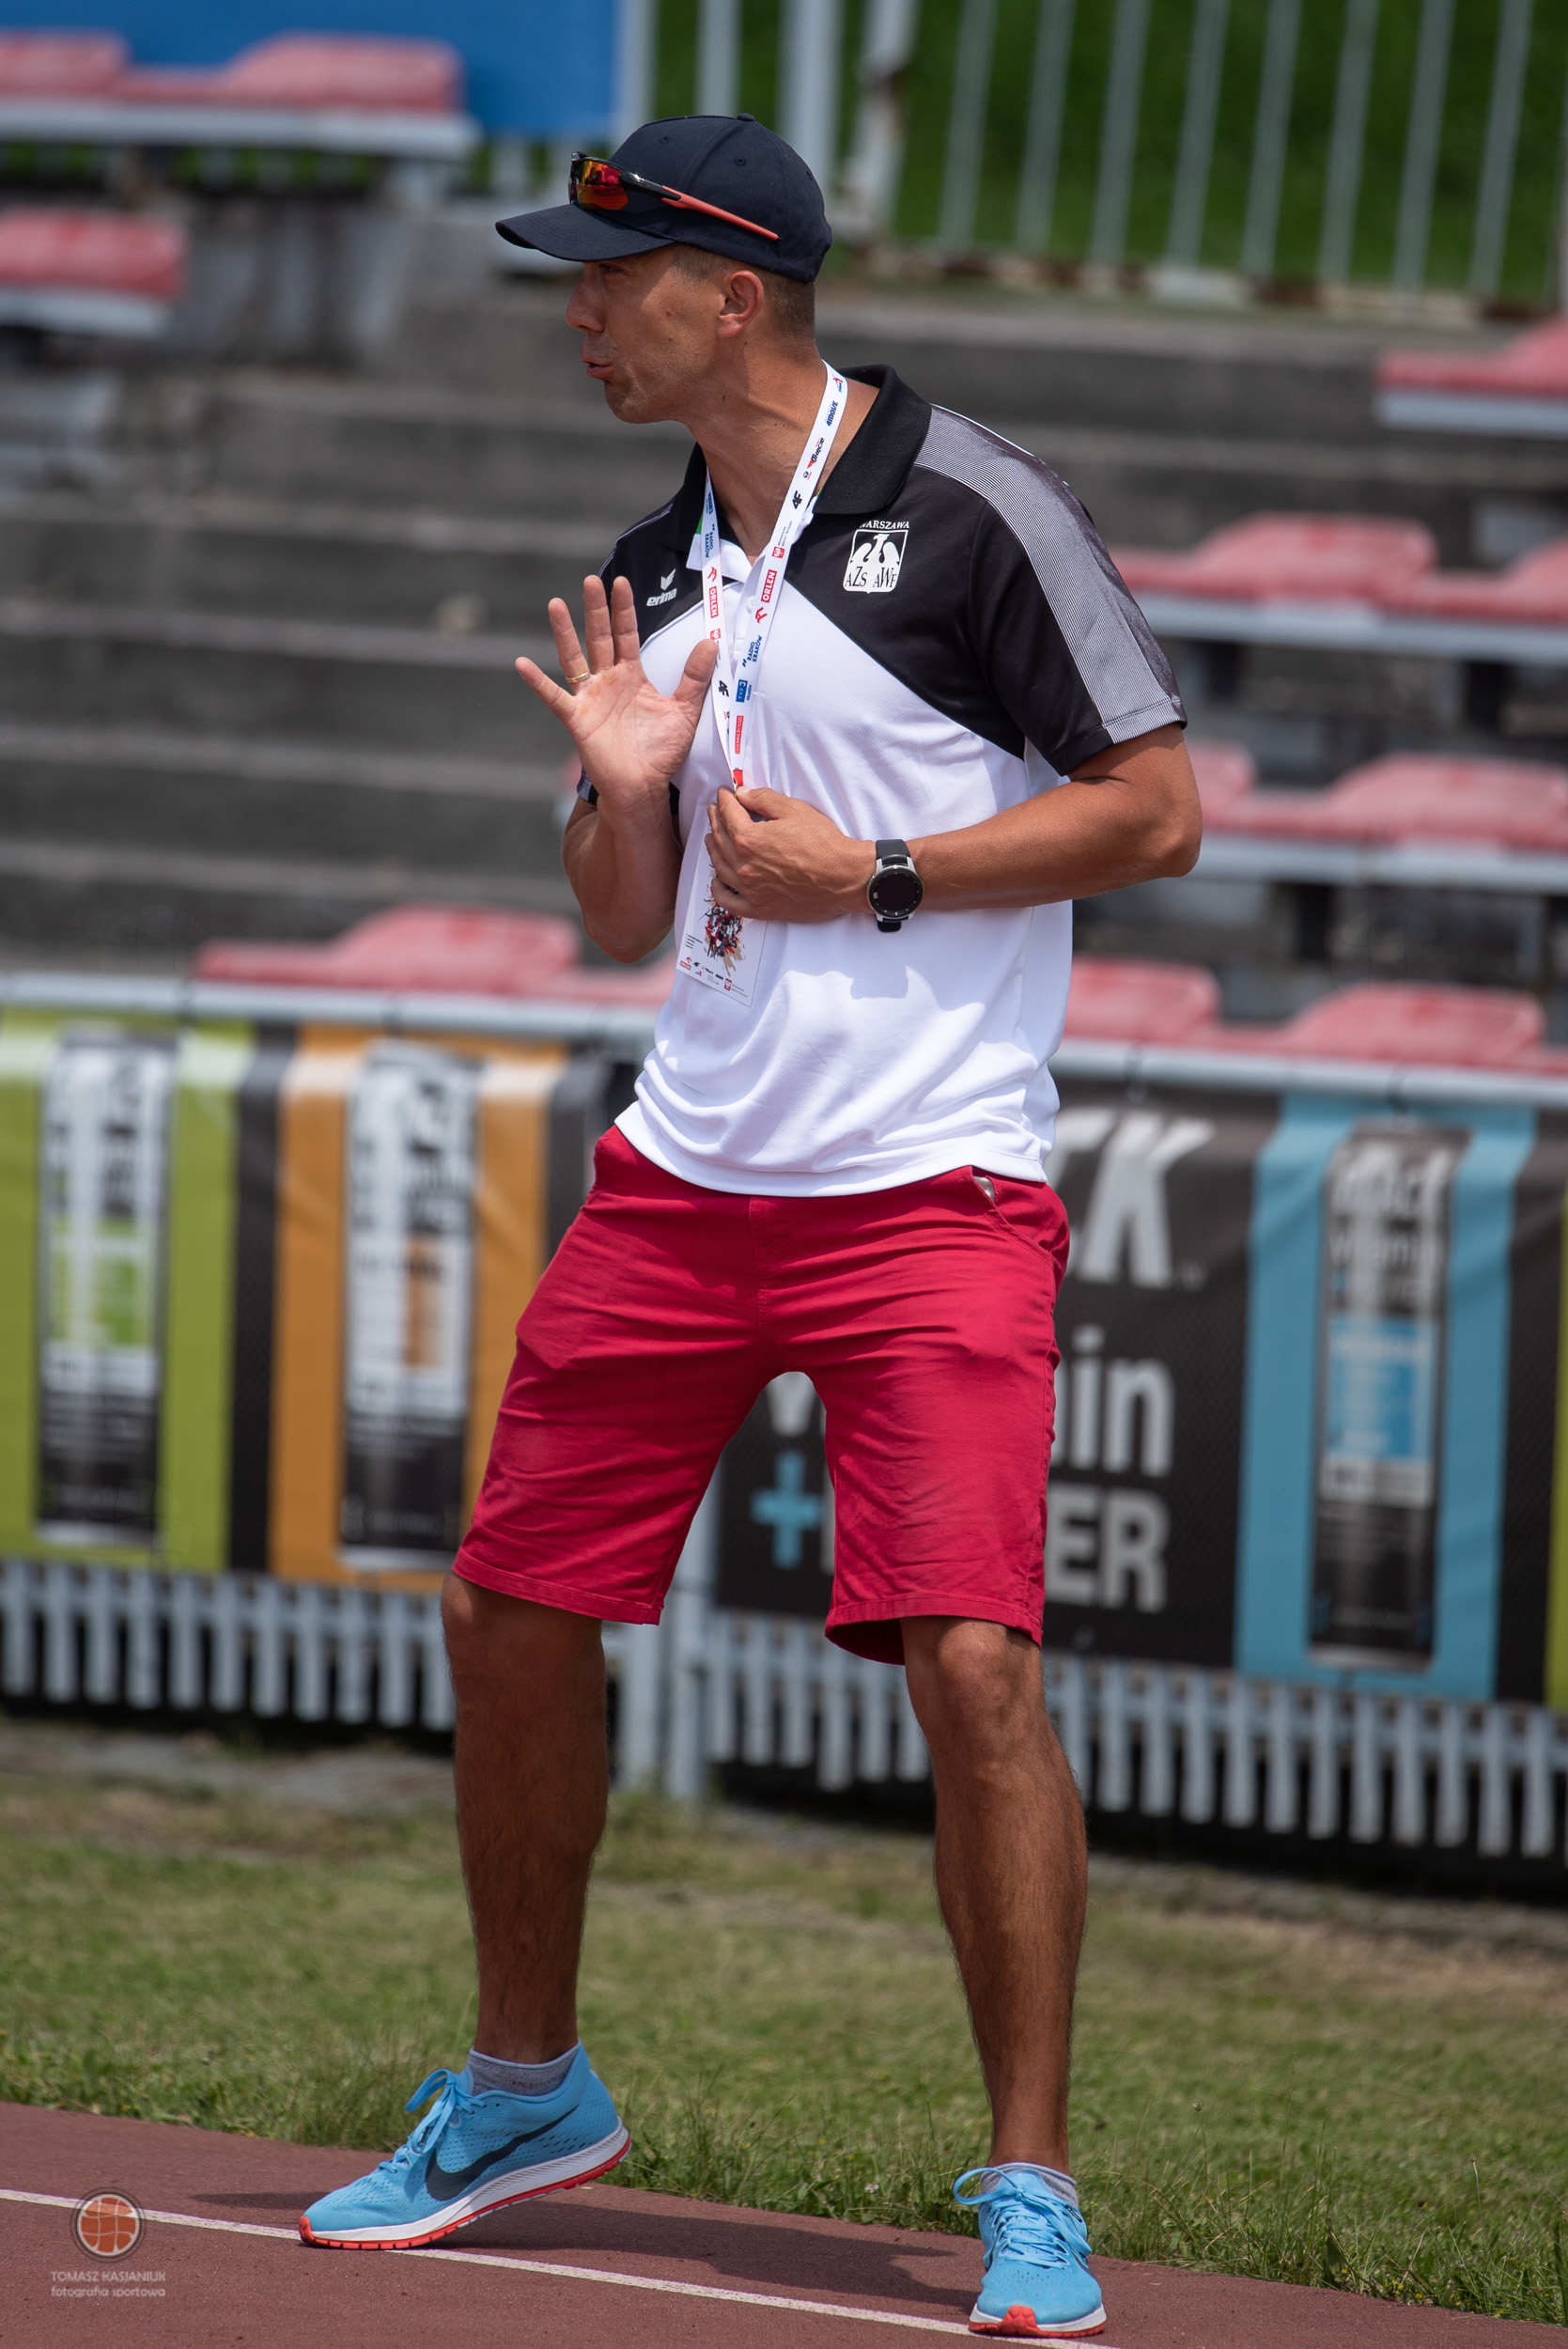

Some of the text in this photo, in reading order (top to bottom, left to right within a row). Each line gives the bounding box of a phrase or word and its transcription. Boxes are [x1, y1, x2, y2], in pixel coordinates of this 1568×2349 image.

[792, 490, 802, 509] 4F
[762, 570, 776, 602] ORLEN
[845, 566, 897, 588] AZS AWF
[646, 587, 676, 606] erima
[709, 586, 718, 617] ORLEN
[747, 642, 755, 661] RADIO
[753, 635, 762, 662] KRAKÓW
[718, 679, 729, 697] 4F
